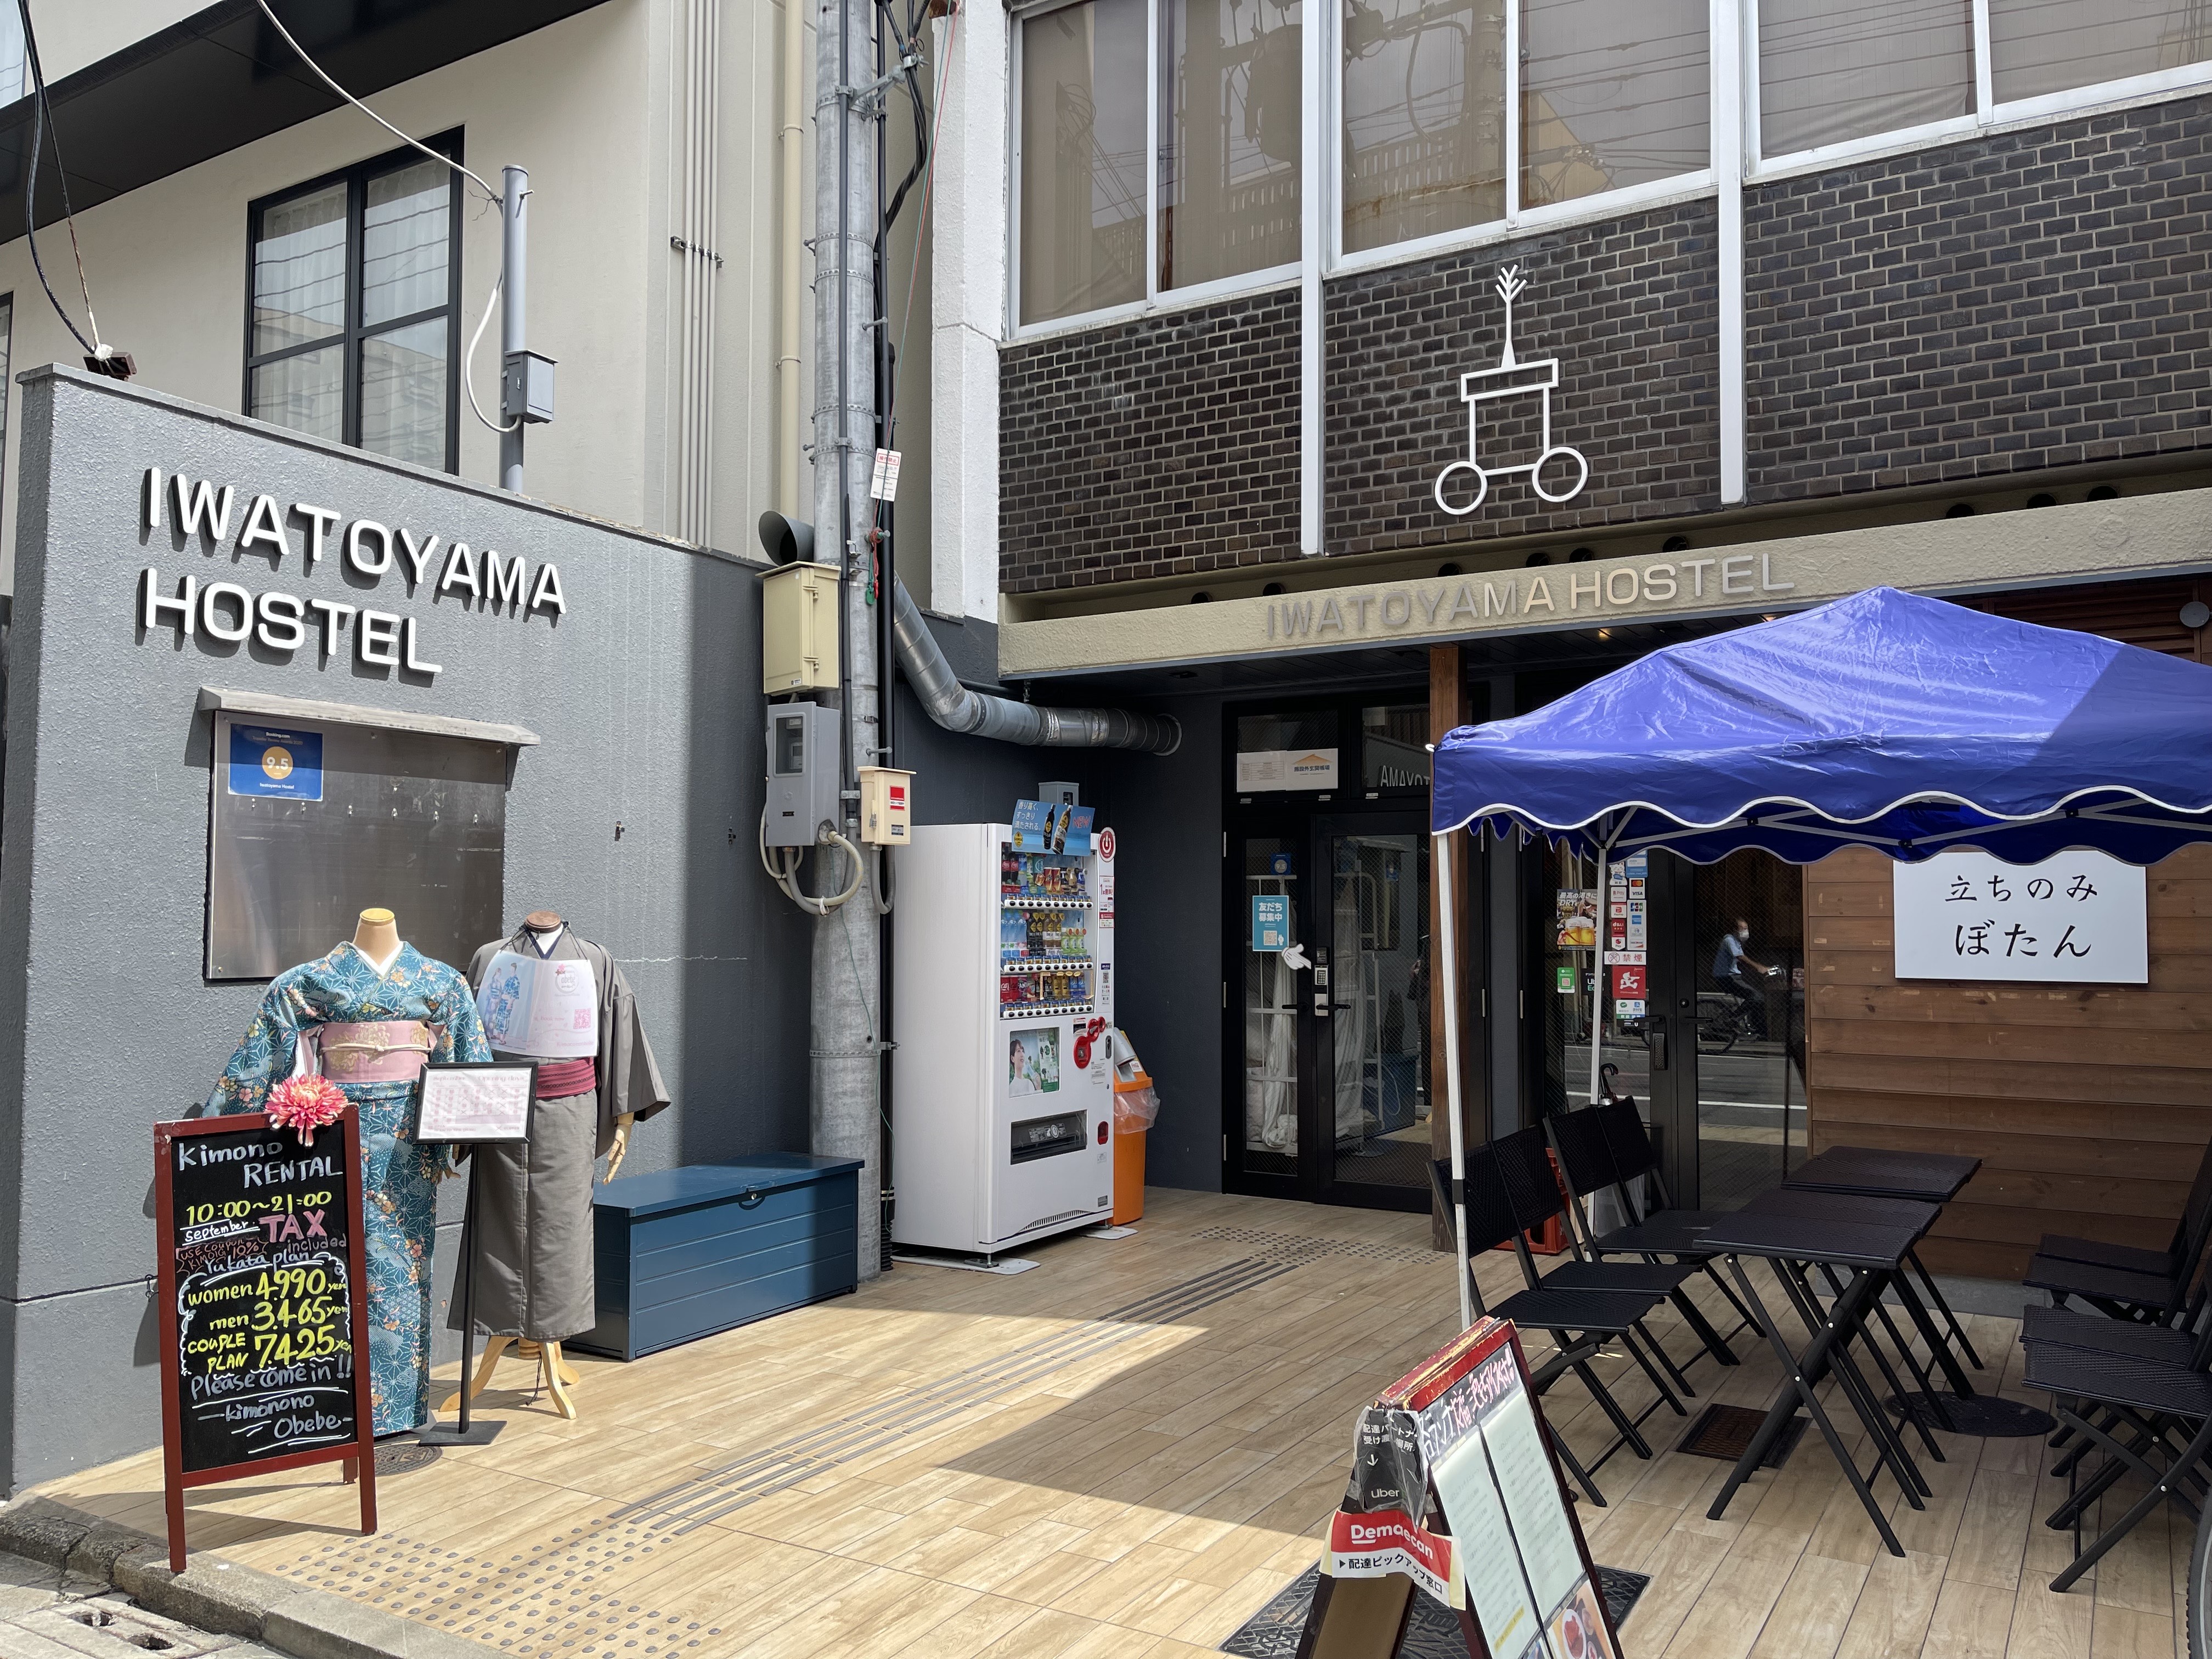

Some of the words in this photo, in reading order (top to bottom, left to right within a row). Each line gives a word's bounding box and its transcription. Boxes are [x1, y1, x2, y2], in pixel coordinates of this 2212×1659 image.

[146, 466, 567, 614] IWATOYAMA
[1268, 576, 1556, 638] IWATOYAMA
[1571, 553, 1795, 610] HOSTEL
[144, 568, 443, 674] HOSTEL
[266, 756, 289, 770] 9.5
[1016, 811, 1036, 821] すっきり
[1073, 815, 1091, 829] NEW
[1945, 874, 2098, 902] 立ちのみ
[1259, 902, 1283, 912] 友だち
[1955, 919, 2092, 958] ぼたん
[178, 1142, 283, 1171] Kimono
[244, 1156, 343, 1188] RENTAL
[258, 1209, 328, 1243] TAX
[233, 1242, 259, 1259] 10%
[287, 1233, 347, 1253] included
[273, 1249, 309, 1272] plan
[188, 1284, 253, 1306] women
[327, 1282, 347, 1294] yen
[209, 1314, 249, 1331] men
[251, 1296, 332, 1331] 3.465
[325, 1305, 348, 1318] yen
[332, 1339, 352, 1353] yen
[207, 1352, 249, 1374] PLAN
[191, 1373, 255, 1401] Please
[259, 1368, 307, 1388] come
[1371, 1488, 1400, 1499] Uber
[1350, 1523, 1434, 1561] Demaecan
[1348, 1553, 1443, 1595] 配達ピックアップ窓口
